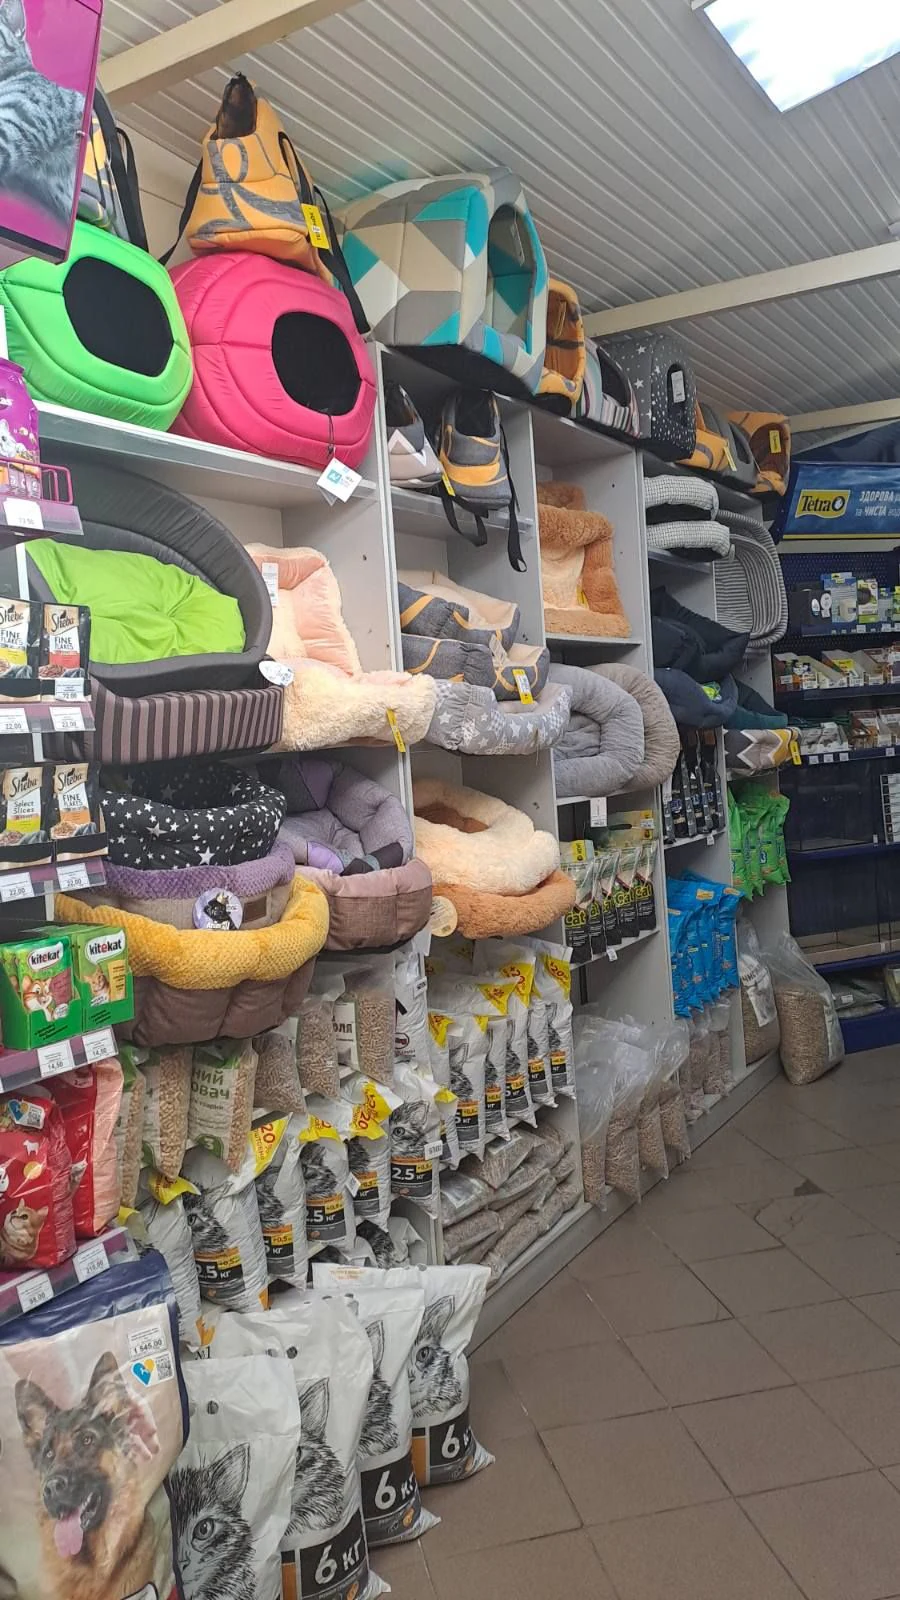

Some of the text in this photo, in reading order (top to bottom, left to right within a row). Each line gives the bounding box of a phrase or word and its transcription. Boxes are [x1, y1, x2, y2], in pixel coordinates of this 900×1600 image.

[802, 496, 831, 512] Tetra
[51, 612, 75, 633] Sheba
[55, 636, 72, 645] FINE
[9, 776, 38, 798] Sheba
[57, 770, 82, 792] Sheba
[62, 793, 81, 801] FINE
[564, 910, 587, 927] Cat
[89, 939, 122, 956] kitekat
[31, 950, 60, 965] kitekat
[192, 1068, 224, 1085] ний
[191, 1083, 230, 1100] овач
[272, 1247, 283, 1255] кг
[219, 1270, 231, 1279] кг
[441, 1423, 460, 1460] 6
[374, 1469, 397, 1510] 6
[314, 1536, 362, 1585] 6 кг
